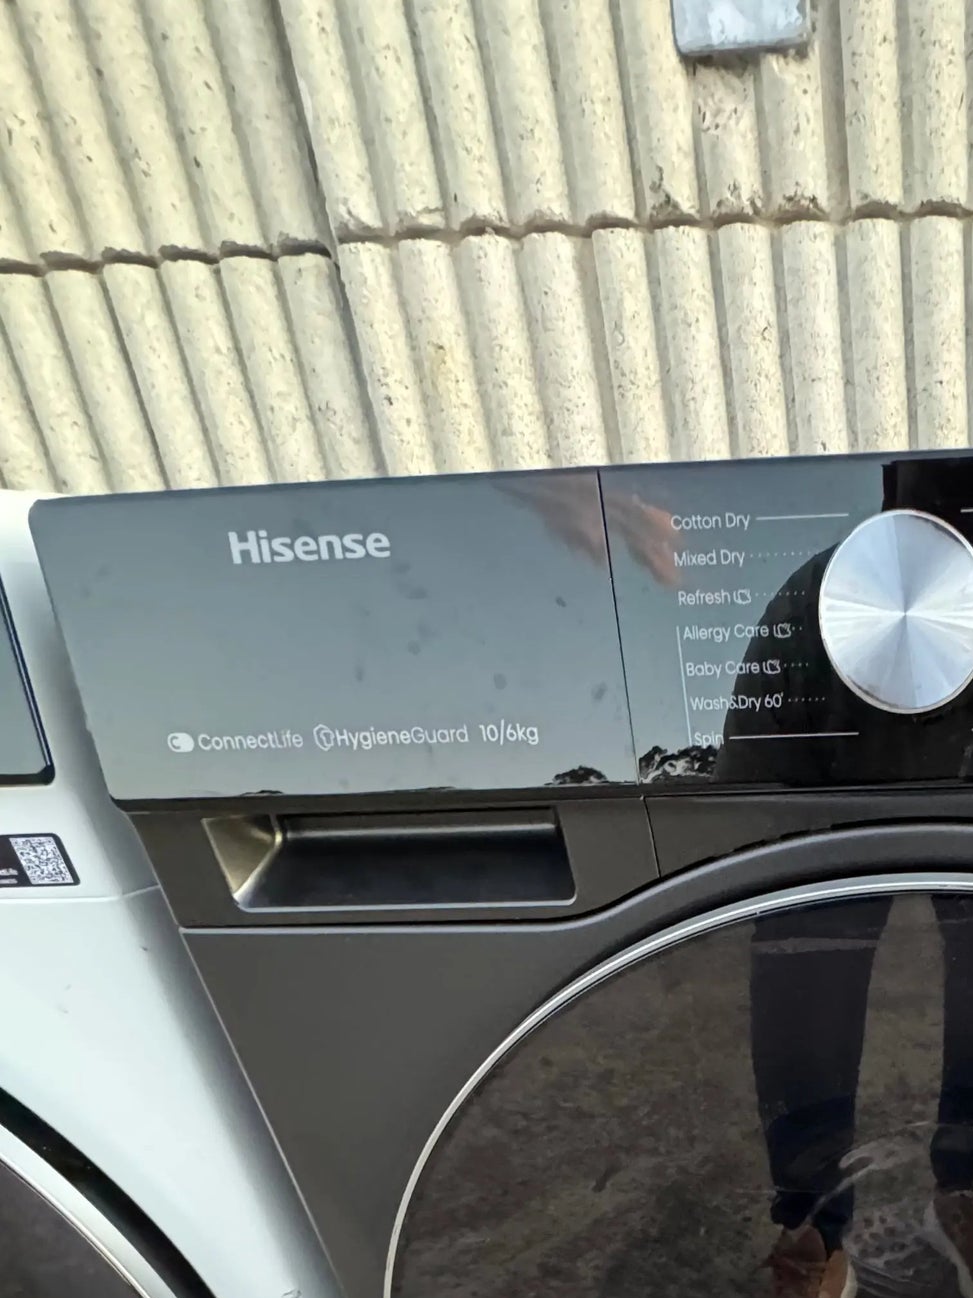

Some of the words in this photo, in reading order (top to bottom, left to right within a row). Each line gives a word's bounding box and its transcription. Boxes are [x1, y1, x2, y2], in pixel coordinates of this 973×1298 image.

[671, 514, 722, 531] Cotton
[725, 513, 750, 531] Dry
[228, 529, 391, 564] Hisense
[674, 550, 717, 567] Mixed
[720, 550, 745, 568] Dry
[678, 590, 730, 606] Refresh
[683, 625, 730, 643] Allergy
[734, 624, 769, 639] Care
[686, 662, 722, 678] Baby
[725, 660, 760, 674] Care
[690, 694, 761, 712] Wash&Dry
[197, 728, 303, 750] ConnectLife
[336, 724, 469, 751] HygieneGuard
[479, 719, 539, 746] 10/6kg
[694, 731, 724, 747] Spin
